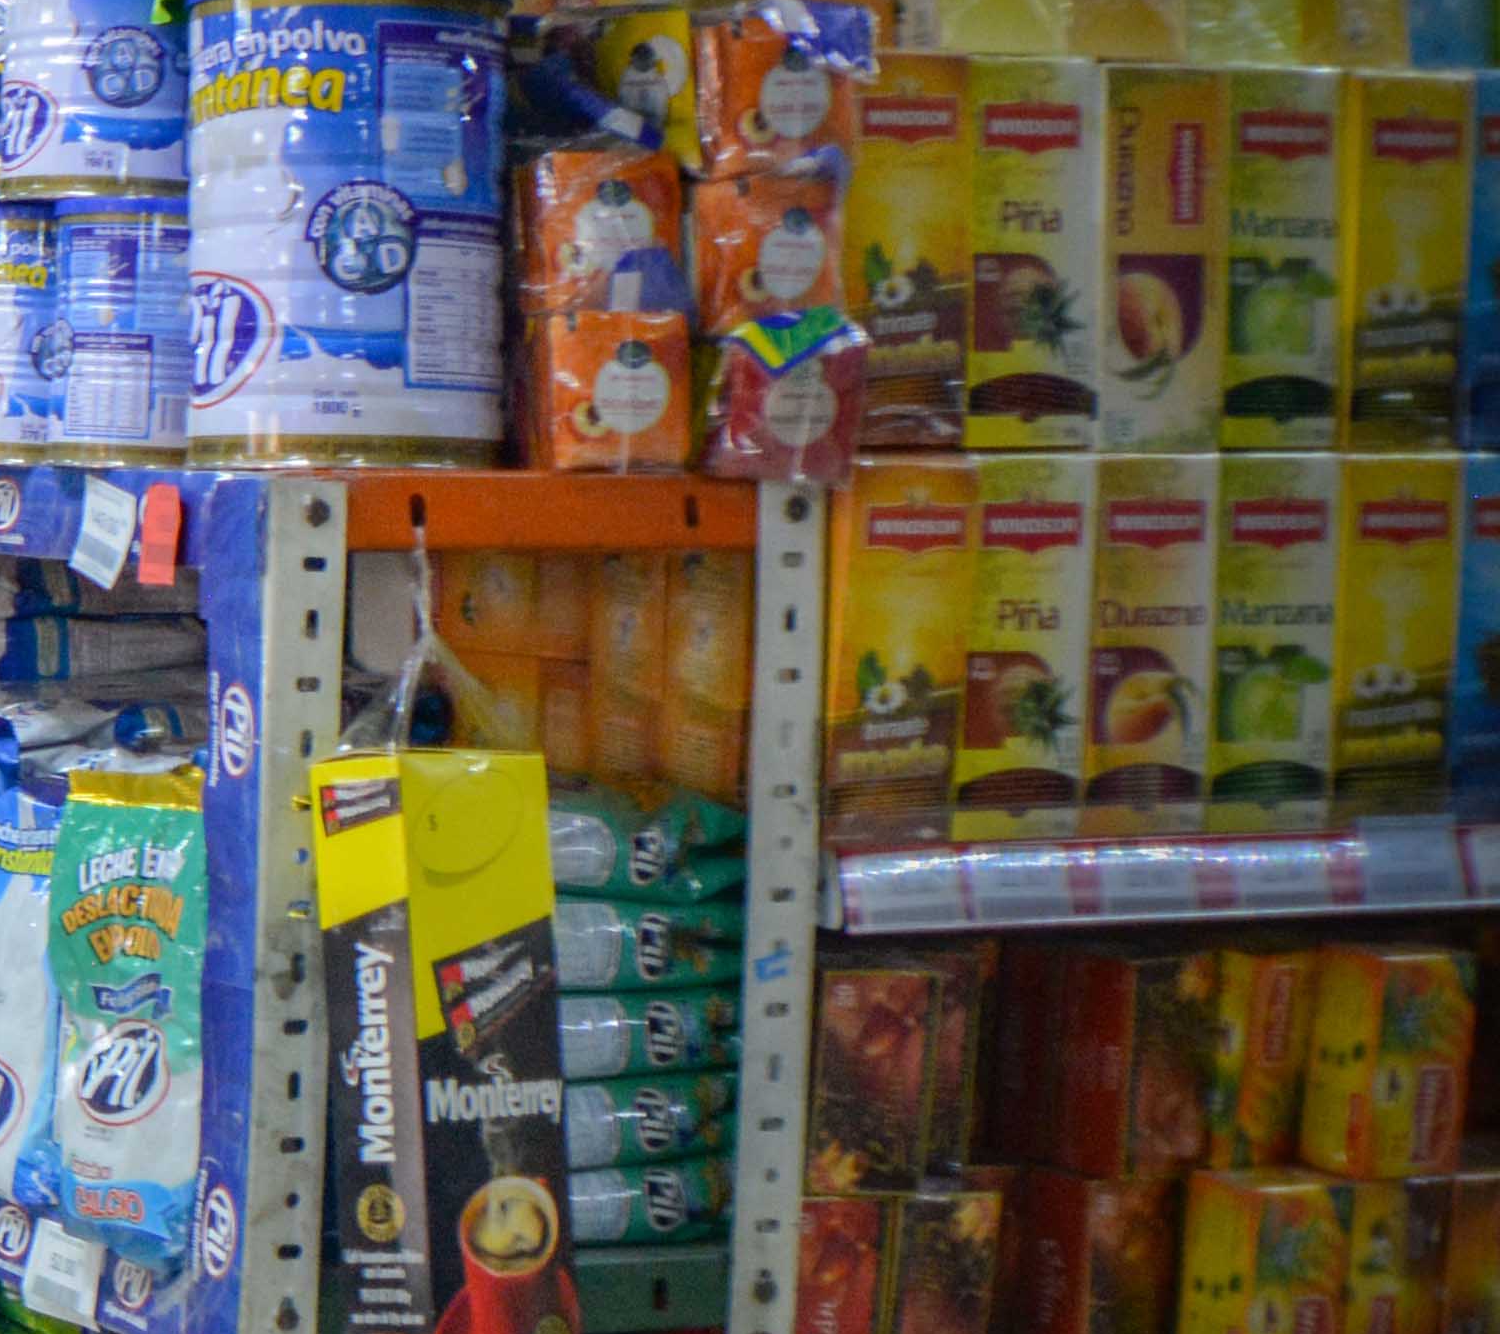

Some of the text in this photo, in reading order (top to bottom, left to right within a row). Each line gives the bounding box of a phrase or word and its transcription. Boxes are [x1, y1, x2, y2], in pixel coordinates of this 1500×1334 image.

[267, 19, 368, 59] polvo
[349, 207, 380, 239] A
[382, 243, 408, 275] D
[996, 596, 1062, 632] Piña
[355, 941, 397, 1164] Monterrey
[427, 1075, 563, 1125] Monterrey
